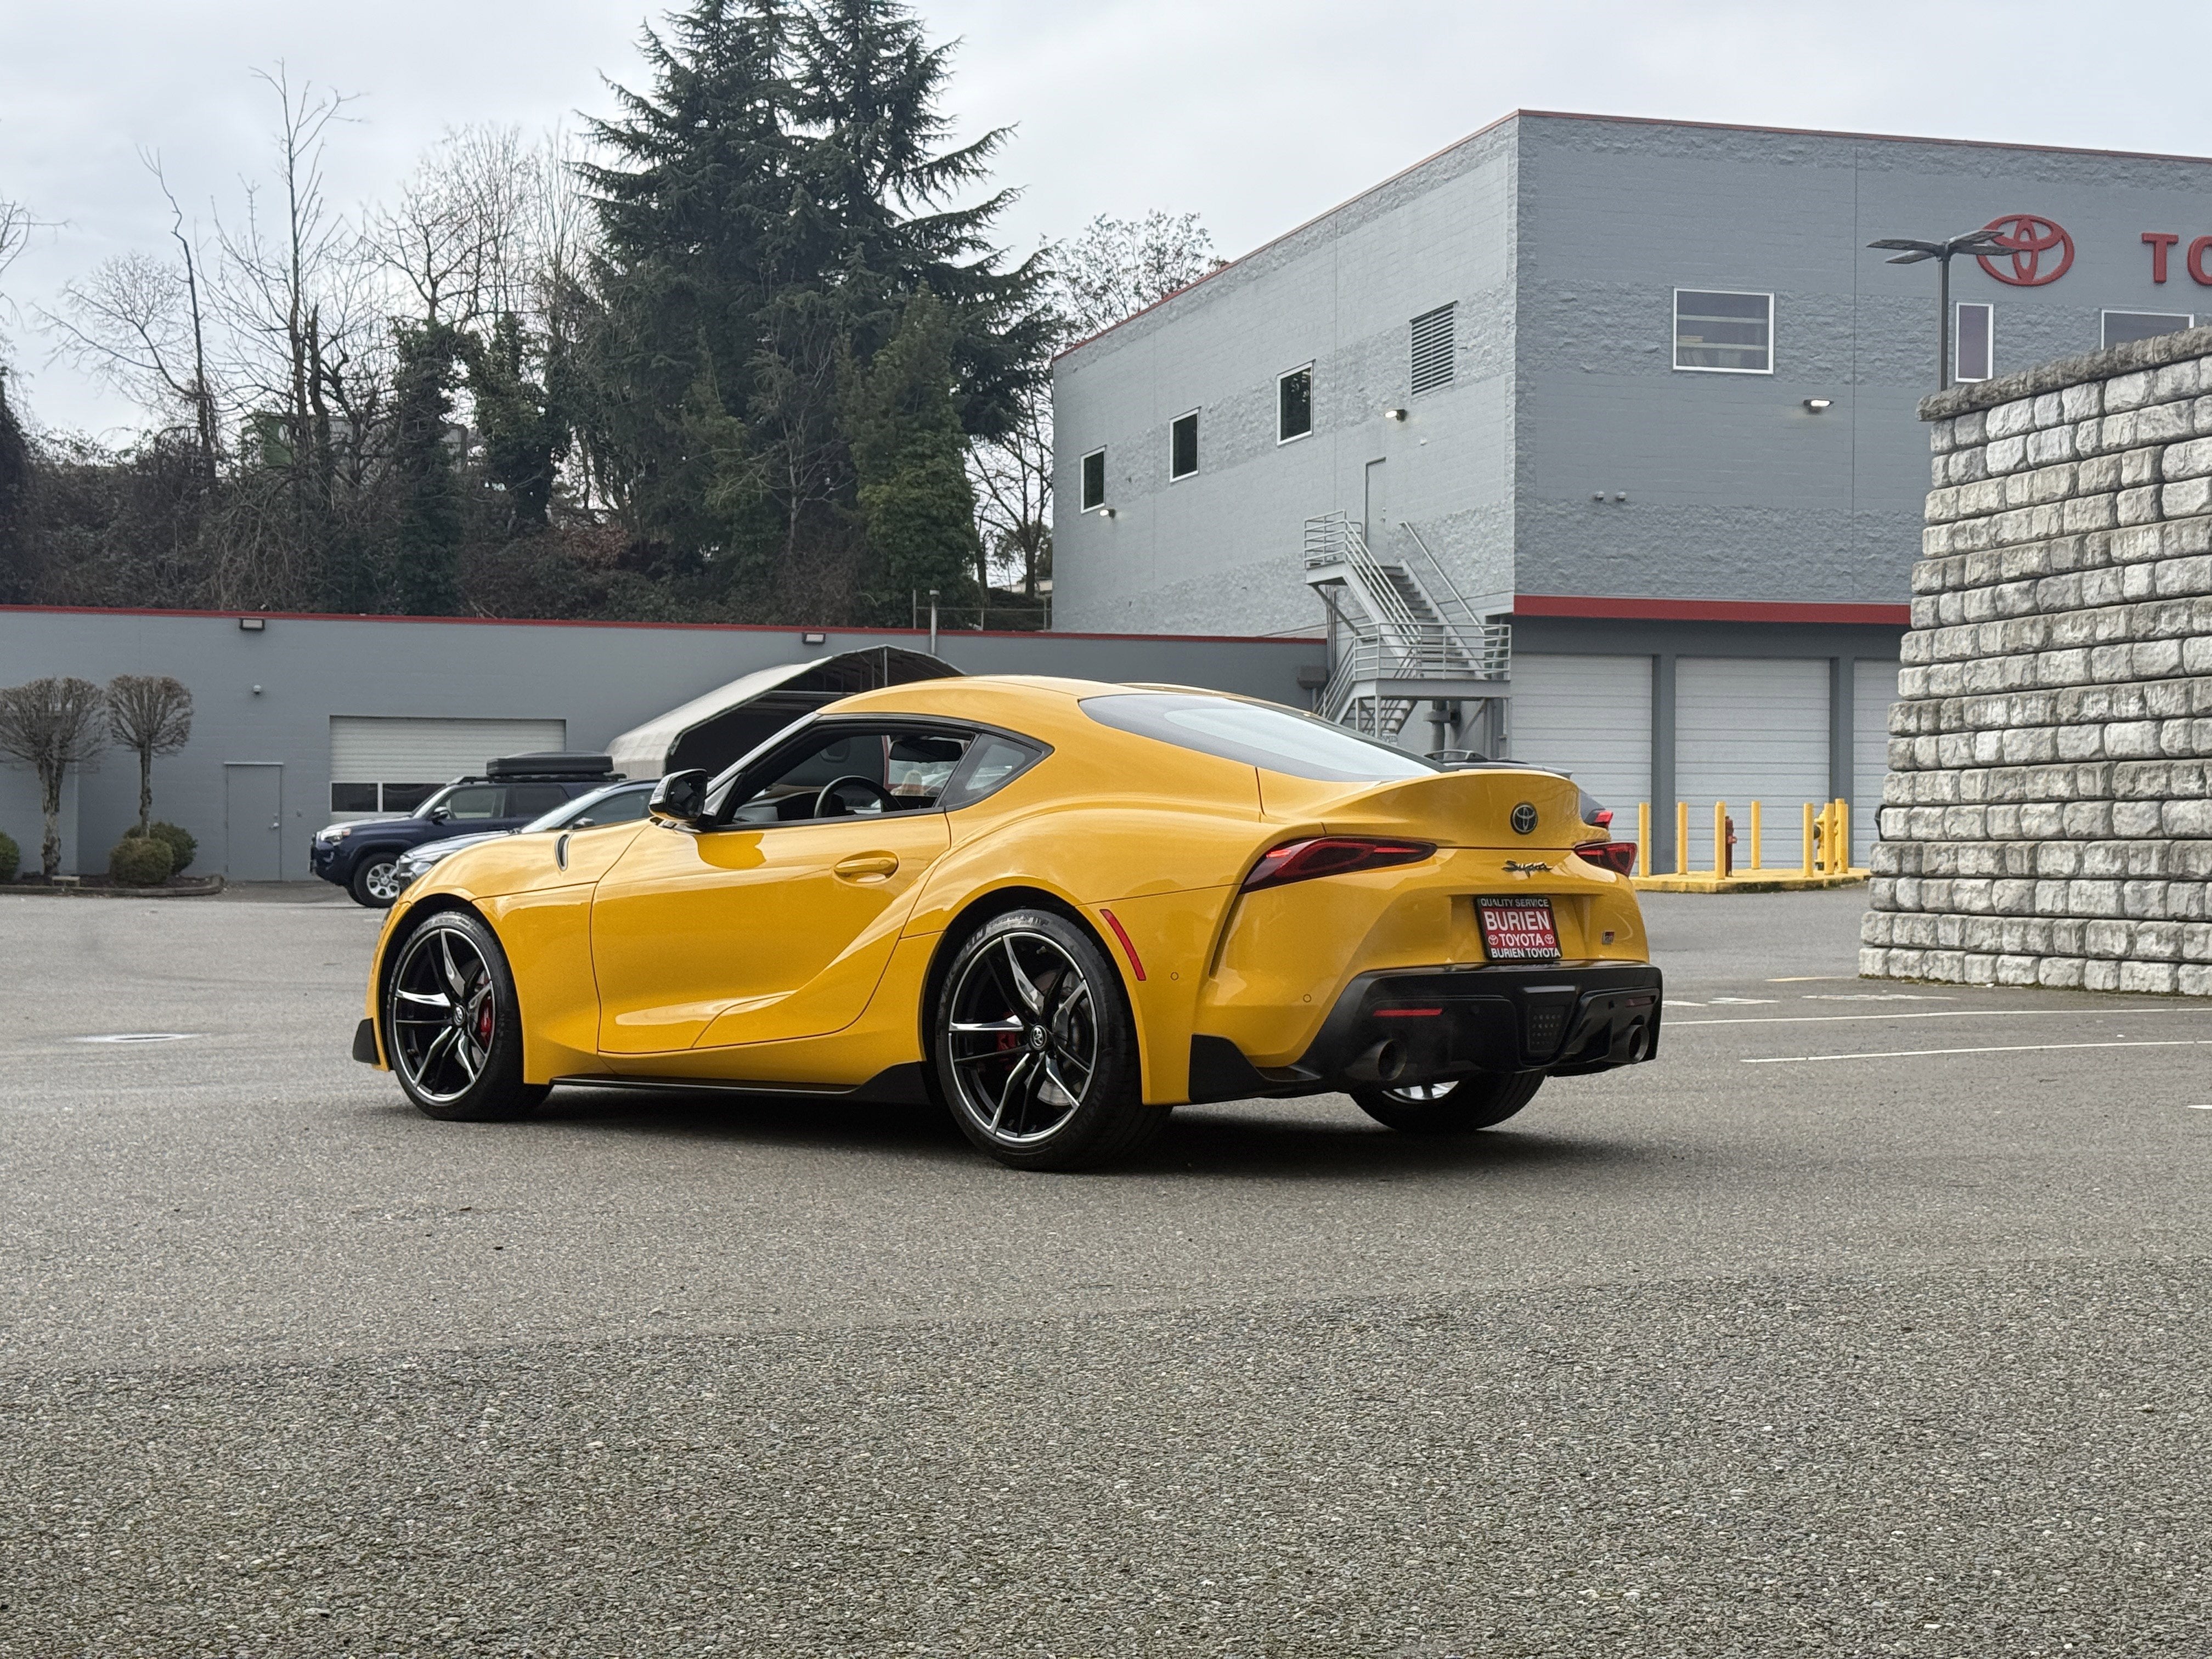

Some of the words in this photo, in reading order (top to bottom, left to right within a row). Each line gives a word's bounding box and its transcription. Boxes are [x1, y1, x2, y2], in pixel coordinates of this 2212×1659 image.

[1501, 860, 1553, 878] Supra
[1481, 898, 1513, 907] QUALITY
[1484, 911, 1550, 931] BURIEN
[1499, 933, 1545, 946] TOYOTA
[1491, 948, 1525, 958] BURIEN
[1526, 947, 1561, 958] TOYOTA
